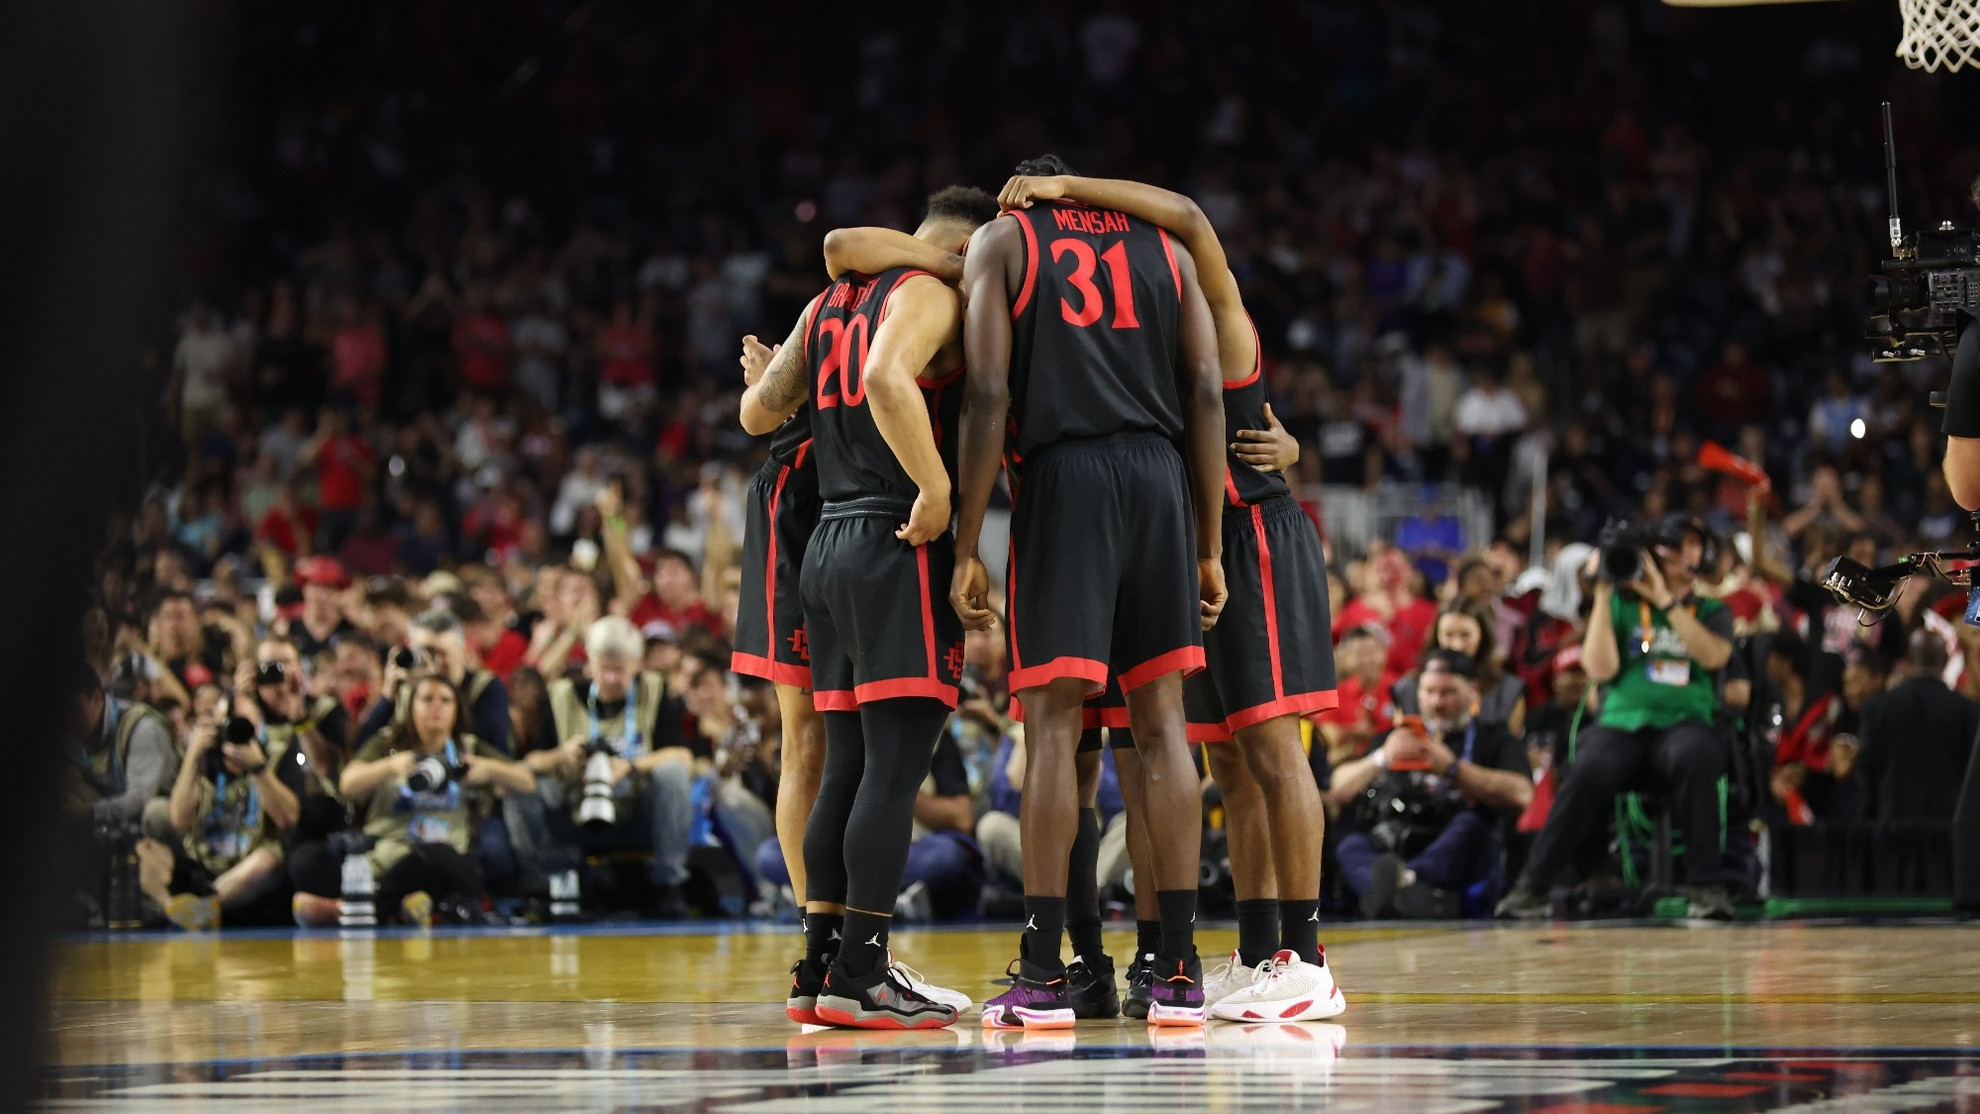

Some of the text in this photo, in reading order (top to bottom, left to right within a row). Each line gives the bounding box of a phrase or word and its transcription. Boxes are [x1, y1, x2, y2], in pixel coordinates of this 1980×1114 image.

[1052, 208, 1131, 234] MENSAH
[1049, 238, 1140, 329] 31
[817, 313, 868, 410] 20
